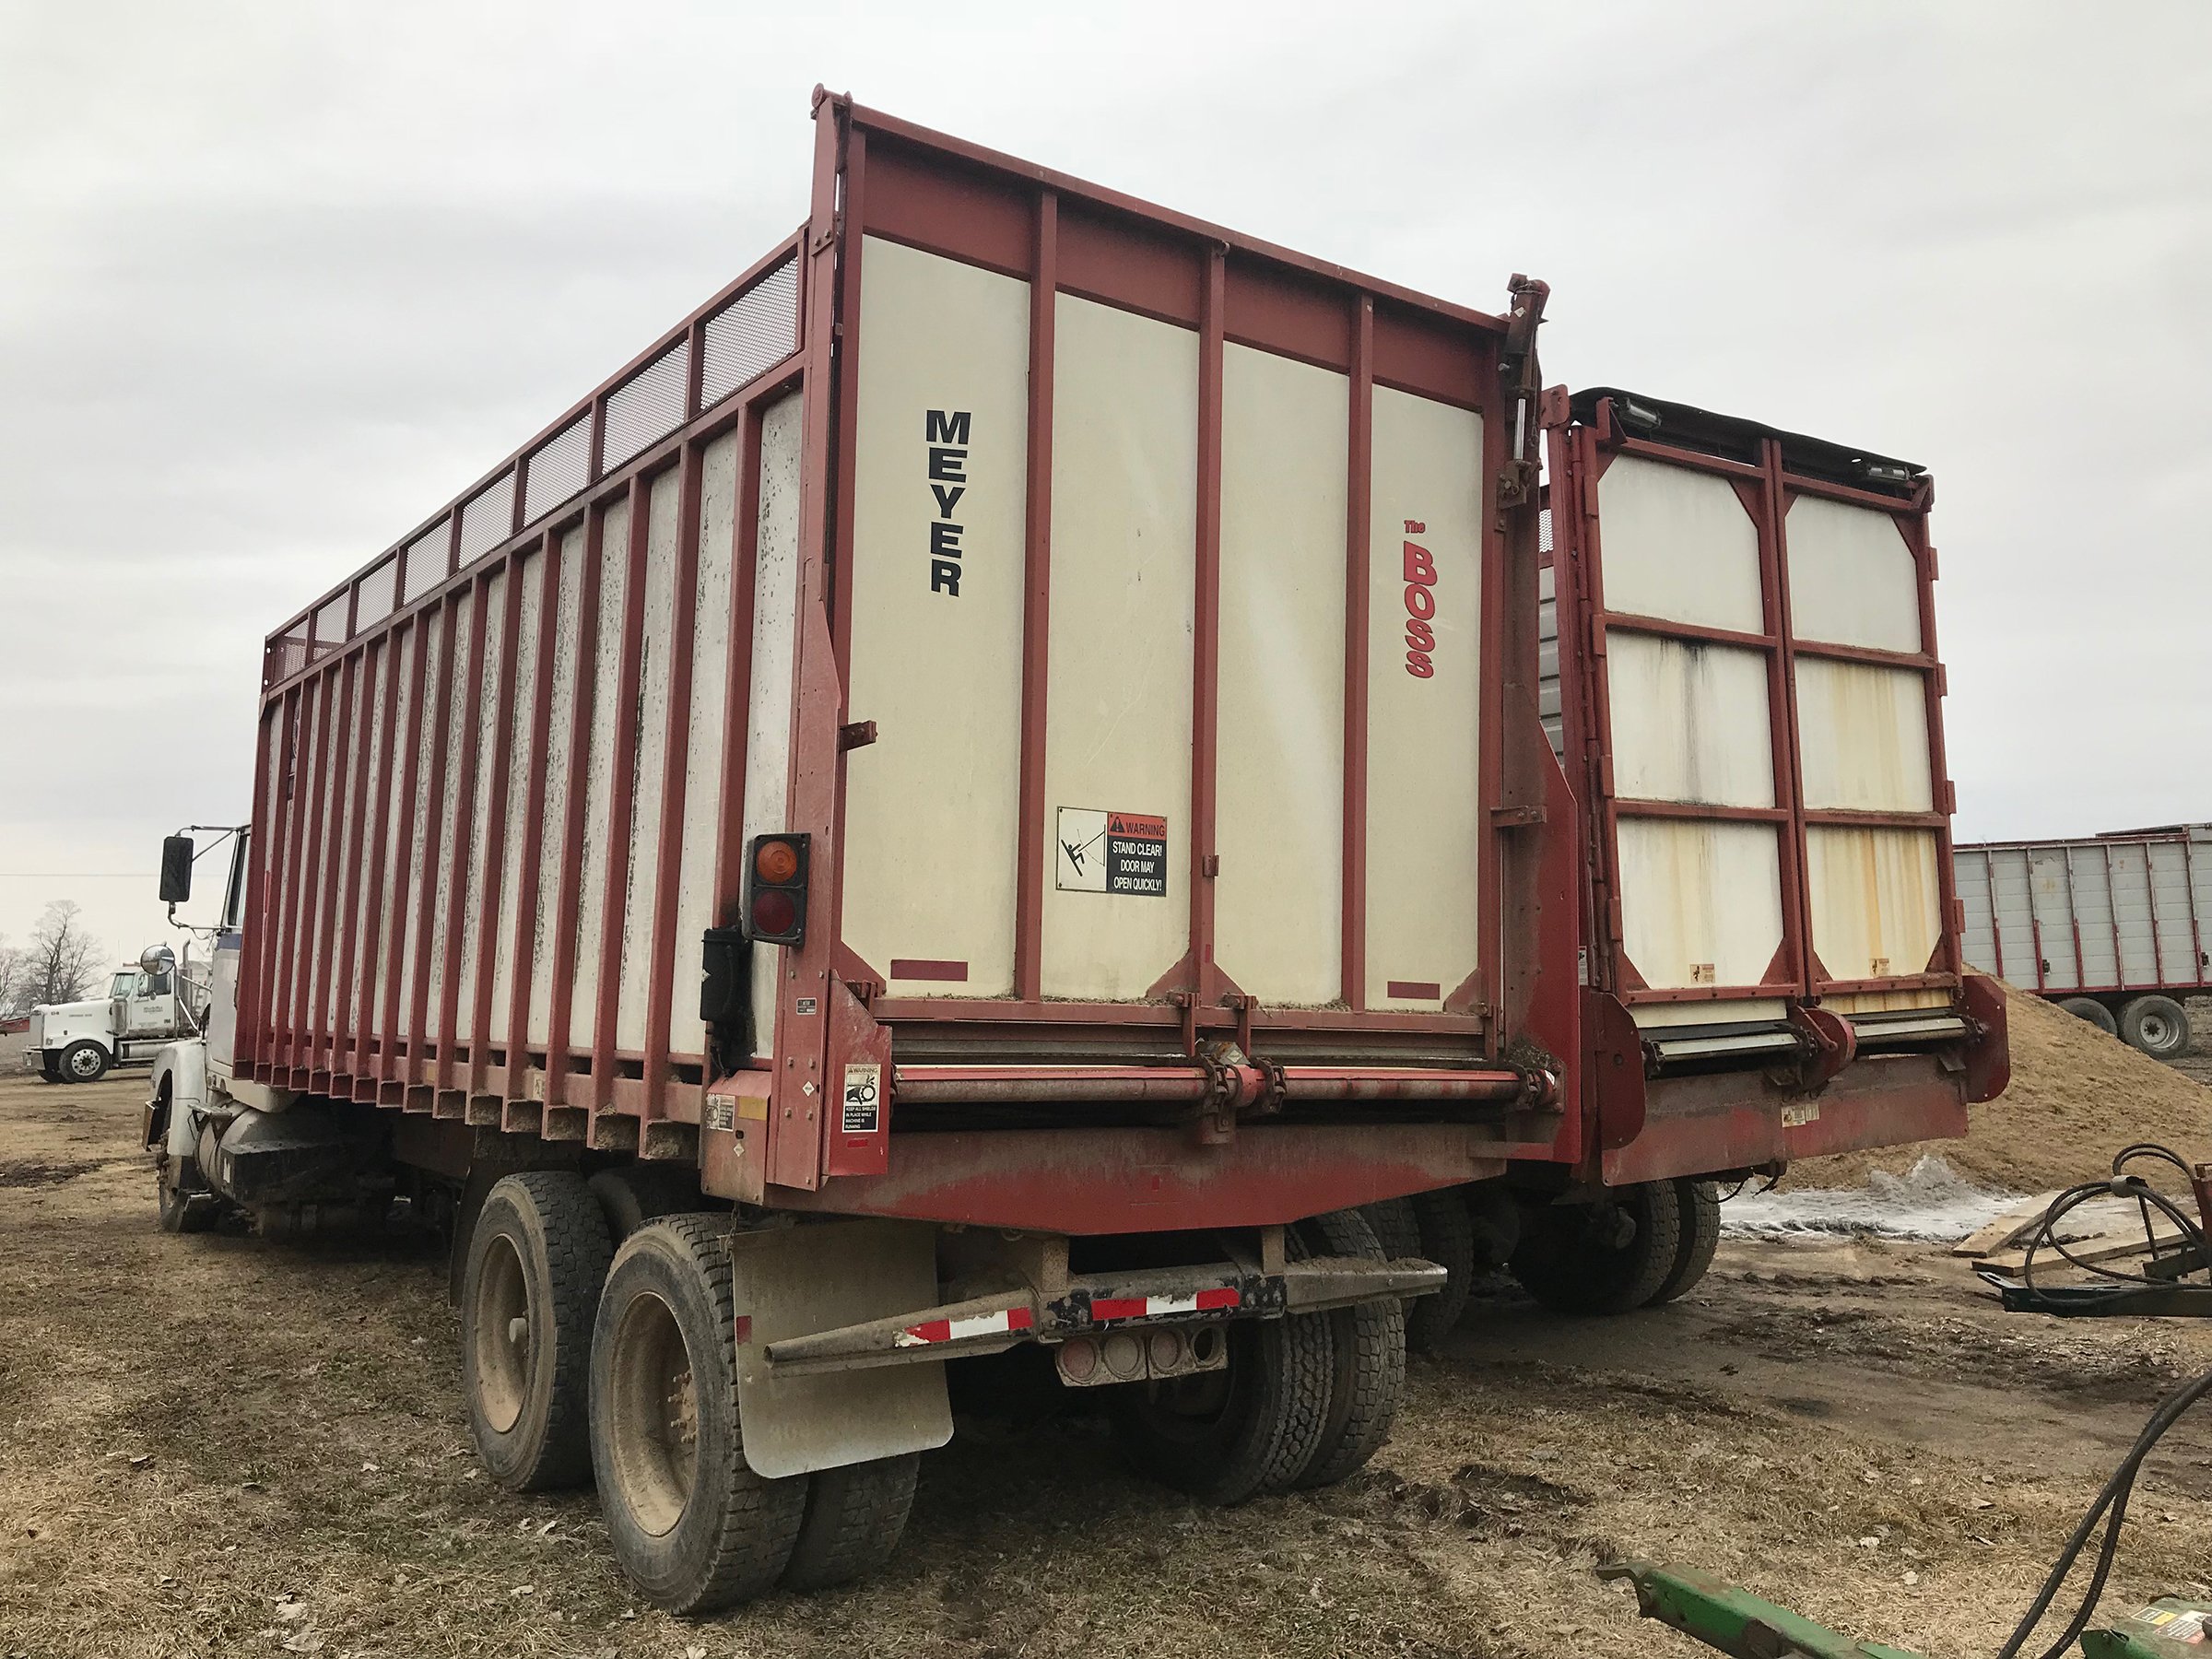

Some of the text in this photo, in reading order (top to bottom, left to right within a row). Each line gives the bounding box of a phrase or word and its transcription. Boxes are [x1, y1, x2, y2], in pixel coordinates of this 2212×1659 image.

[925, 409, 971, 598] MEYER
[1404, 520, 1426, 534] The
[1404, 540, 1438, 679] BOSS
[1125, 822, 1165, 837] WARNING
[1112, 841, 1162, 857] STAND CLEAR!
[1120, 859, 1155, 874] DOOR MAY
[1113, 876, 1162, 891] OPEN QUICKLY!
